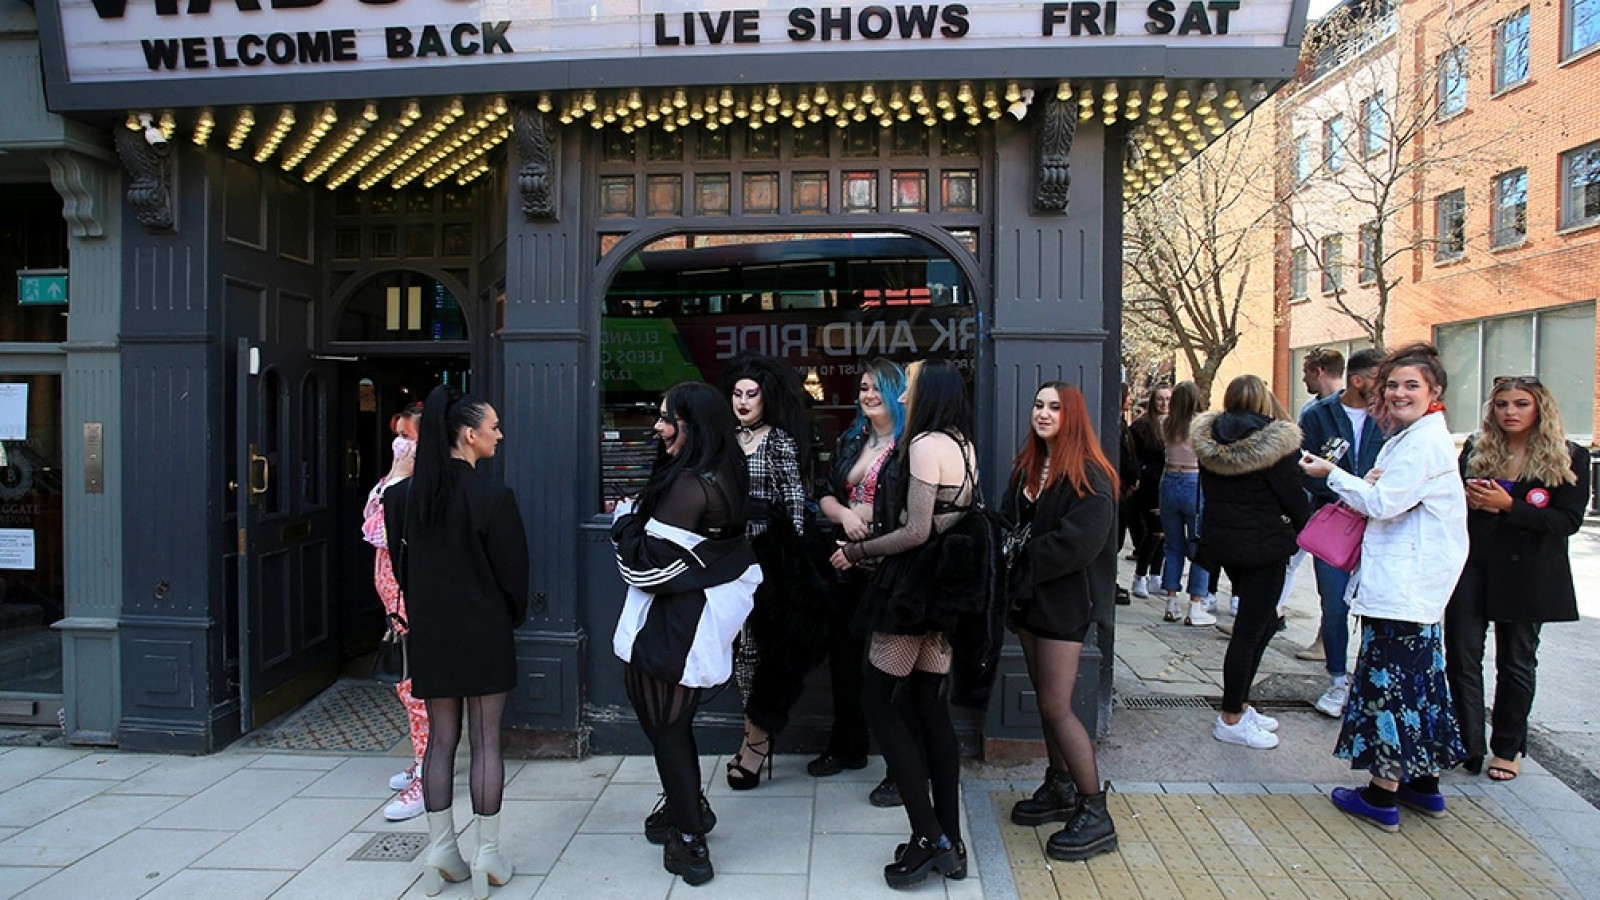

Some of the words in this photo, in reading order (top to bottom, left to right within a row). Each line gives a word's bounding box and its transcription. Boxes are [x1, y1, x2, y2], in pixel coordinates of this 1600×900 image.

[655, 10, 760, 46] LIVE
[787, 4, 969, 42] SHOWS
[1042, 2, 1117, 37] FRI
[1144, 0, 1240, 36] SAT
[140, 29, 360, 70] WELCOME
[385, 21, 513, 60] BACK
